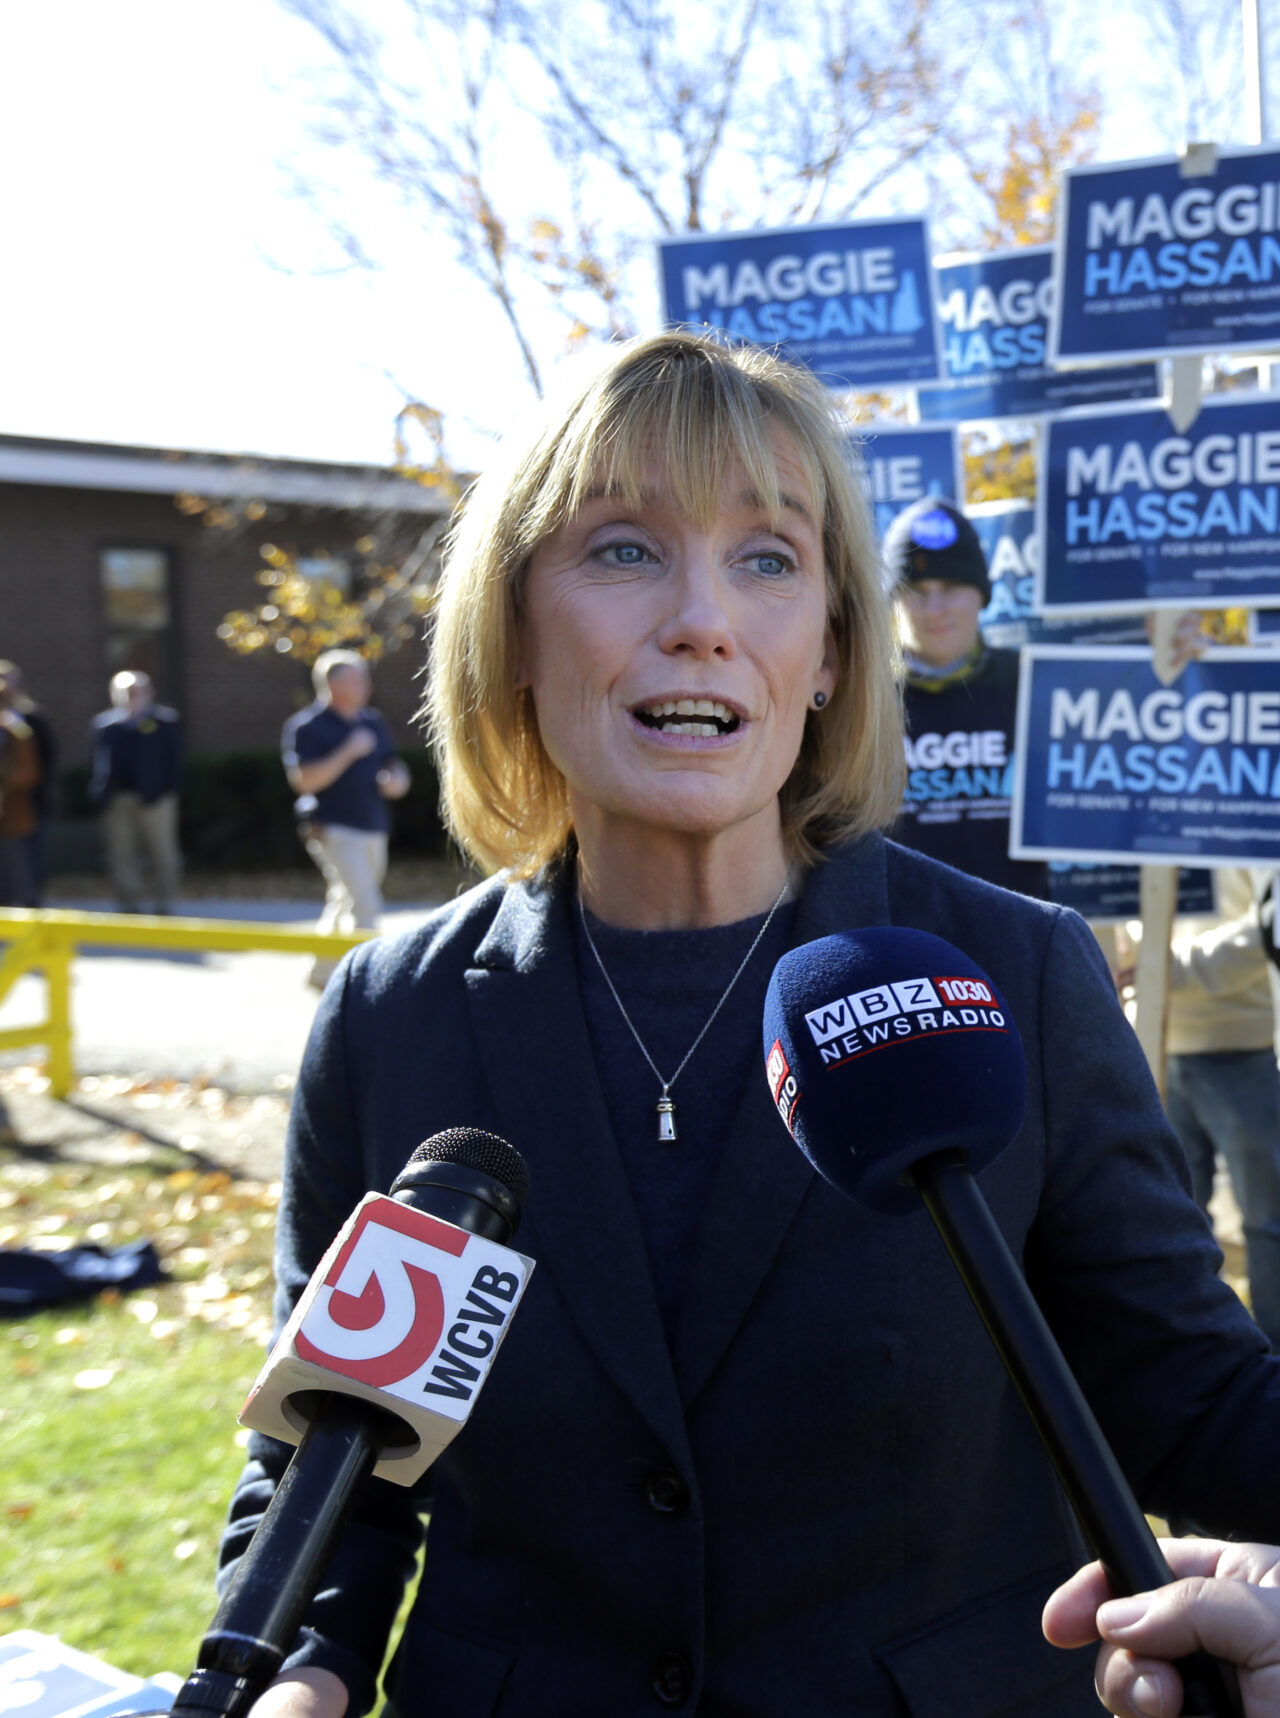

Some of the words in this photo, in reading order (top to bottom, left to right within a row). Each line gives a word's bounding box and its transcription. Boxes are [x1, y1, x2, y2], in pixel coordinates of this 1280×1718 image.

[682, 246, 898, 311] MAGGIE
[1066, 486, 1279, 544] HASSAN
[903, 767, 1000, 800] SSAN
[1046, 742, 1270, 797] HASSAN
[809, 984, 932, 1036] WBZ
[939, 980, 993, 1003] 1030
[422, 1264, 520, 1402] WCVB
